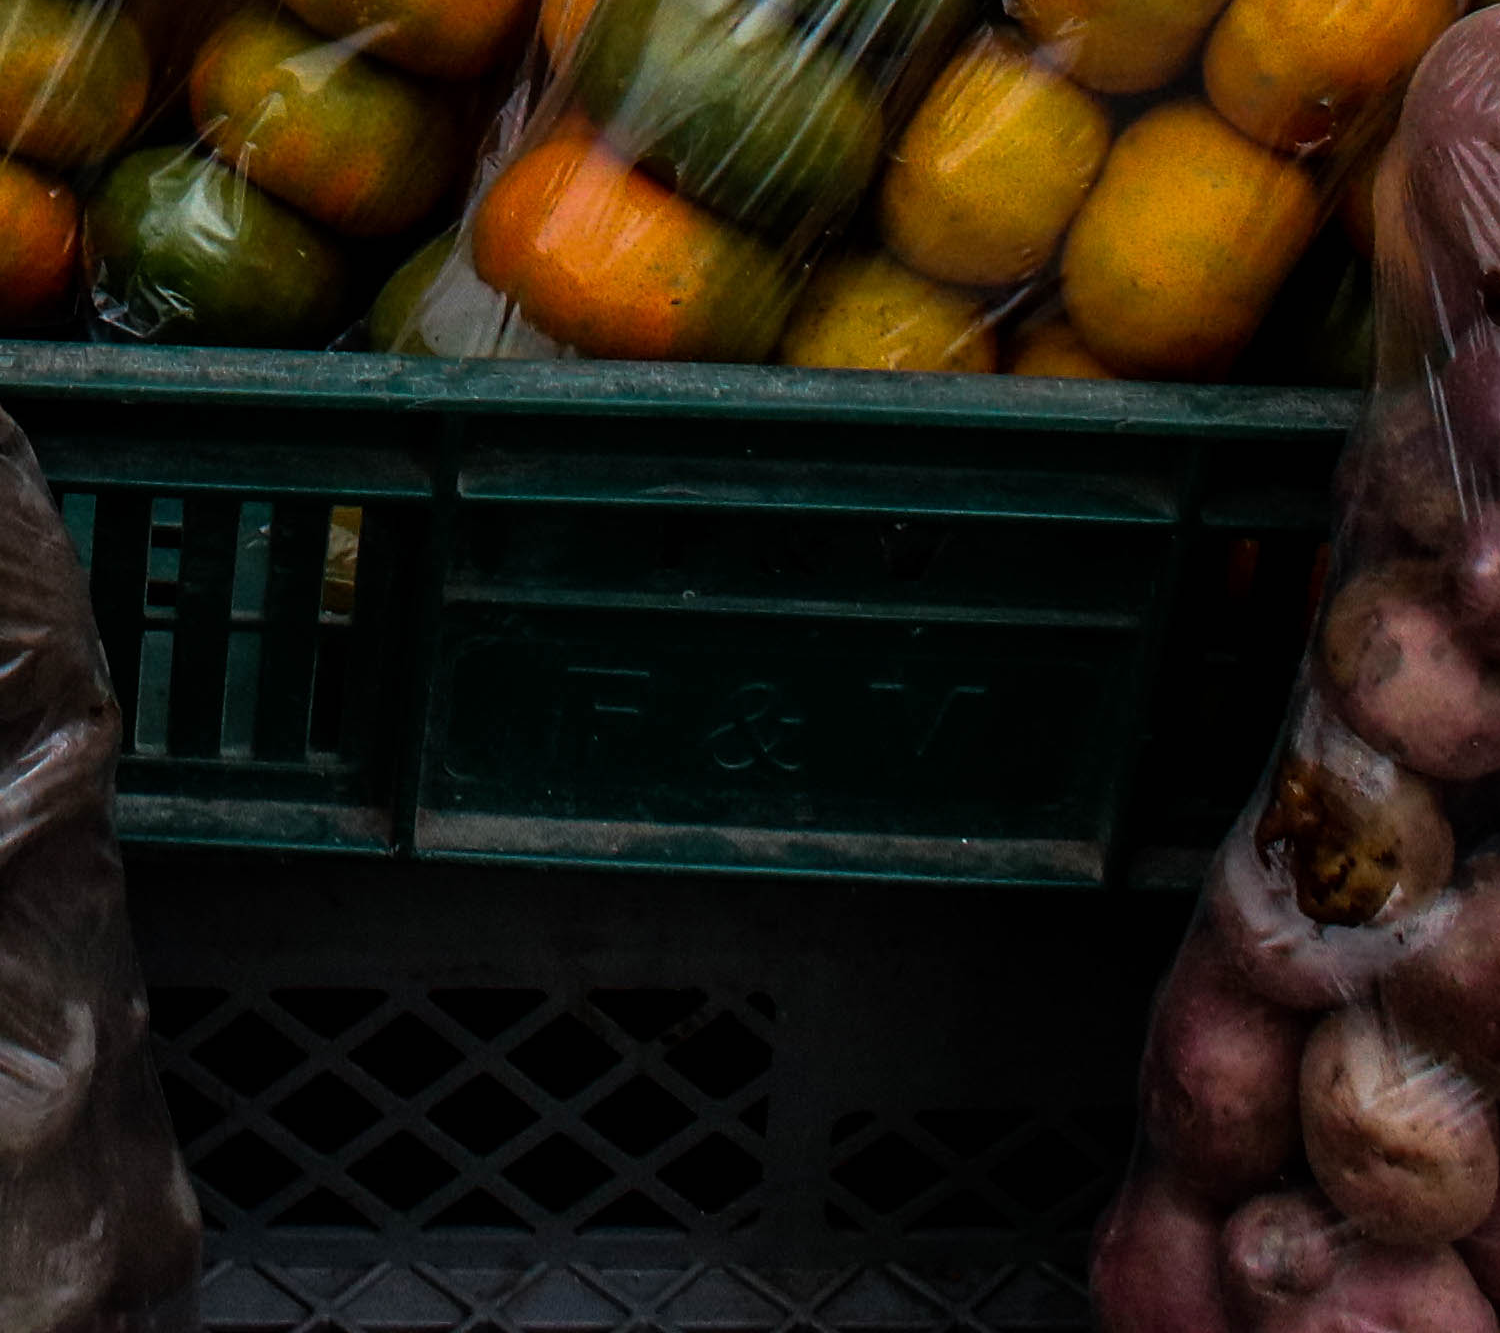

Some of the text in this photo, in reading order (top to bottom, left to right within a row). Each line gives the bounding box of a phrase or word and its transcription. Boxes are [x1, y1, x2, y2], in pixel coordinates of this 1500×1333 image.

[552, 665, 988, 772] F & V
